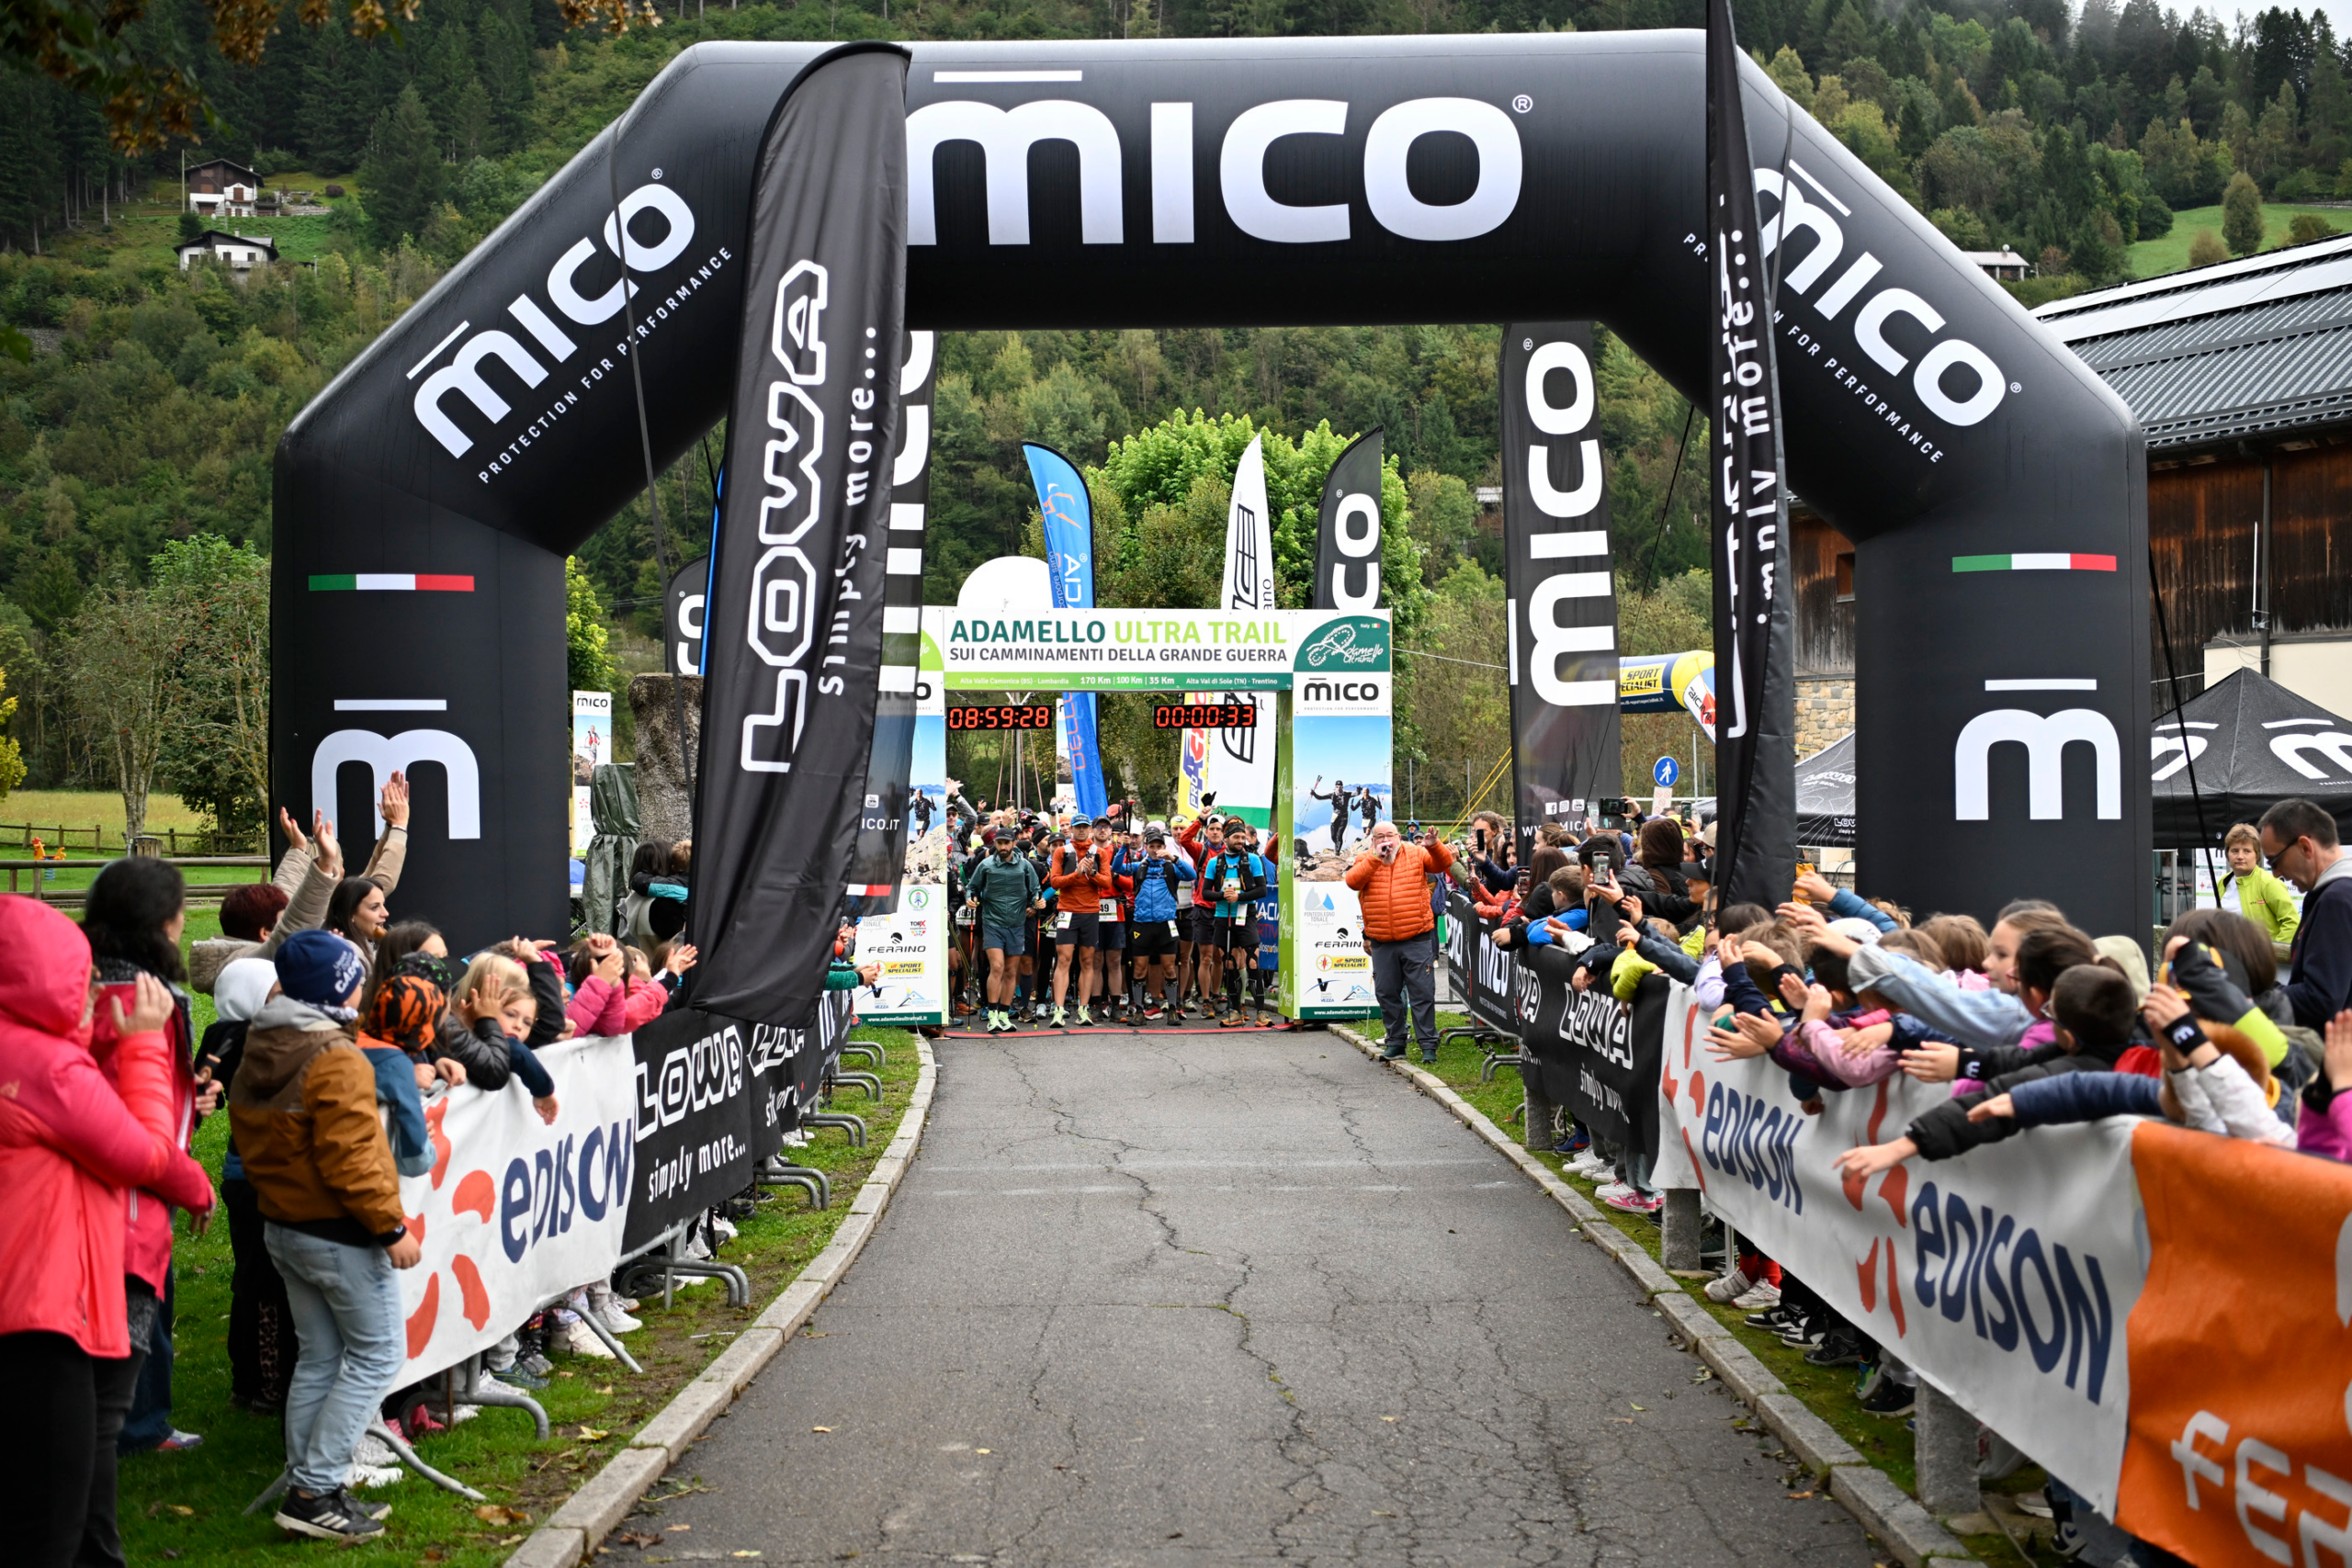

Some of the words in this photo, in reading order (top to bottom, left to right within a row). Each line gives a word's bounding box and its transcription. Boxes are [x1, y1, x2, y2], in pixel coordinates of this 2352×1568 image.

[479, 391, 577, 484] PROTECTION
[581, 356, 614, 389] FOR
[616, 245, 734, 356] PERFORMANCE
[1788, 325, 1821, 356] FOR
[1825, 357, 1943, 464] PERFORMANCE
[846, 327, 877, 506] more...
[741, 259, 829, 773] LOWA
[950, 620, 1105, 643] ADAMELLO
[1114, 621, 1201, 644] ULTRA
[1208, 622, 1287, 644] TRAIL
[950, 648, 975, 660] SUI
[979, 648, 1102, 661] CAMMINAMENTI
[1108, 649, 1156, 661] DELLA
[1159, 649, 1222, 661] GRANDE
[1227, 649, 1287, 661] GUERRA
[1626, 668, 1660, 681] SPORT
[949, 707, 1049, 728] 08:59:28
[1156, 705, 1254, 728] 00:00:33
[867, 945, 926, 953] FERRINO
[1559, 982, 1634, 1070] LOWA
[635, 1025, 743, 1143] LOWA
[648, 1150, 692, 1202] simply
[699, 1134, 746, 1175] more...
